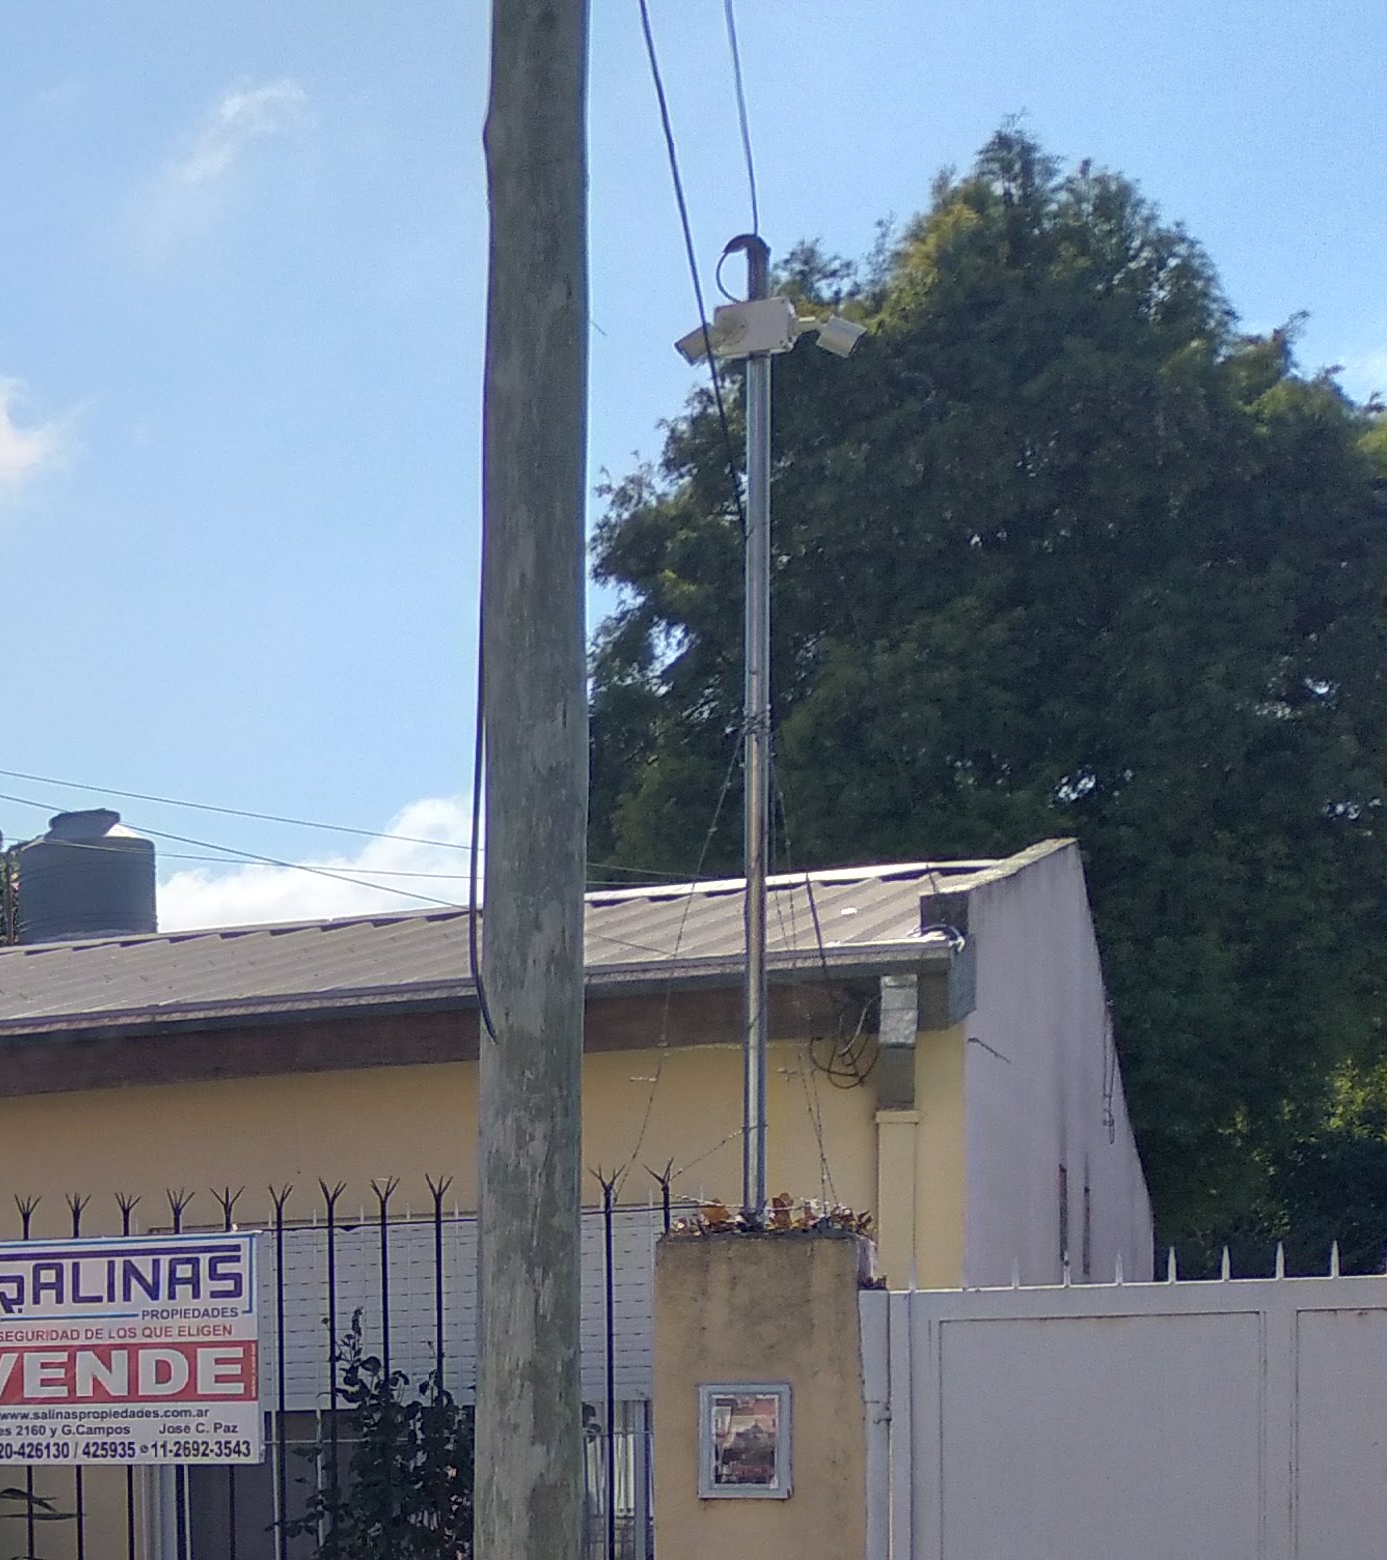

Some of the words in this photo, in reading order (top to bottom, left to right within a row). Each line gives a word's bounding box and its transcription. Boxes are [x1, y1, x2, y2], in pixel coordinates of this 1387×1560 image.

[141, 1307, 239, 1320] PROPIEDADES
[84, 1328, 103, 1340] DE
[108, 1326, 137, 1340] LOS
[141, 1325, 173, 1339] QUE
[177, 1324, 233, 1337] ELIGEN
[0, 1408, 210, 1421] www.salinaspropiedades.com.ar
[15, 1425, 46, 1437] 2160
[50, 1427, 57, 1438] y
[195, 1422, 210, 1434] C.
[213, 1422, 239, 1434] Paz
[82, 1441, 136, 1459] 425935
[151, 1440, 251, 1458] 11-2692-3543
